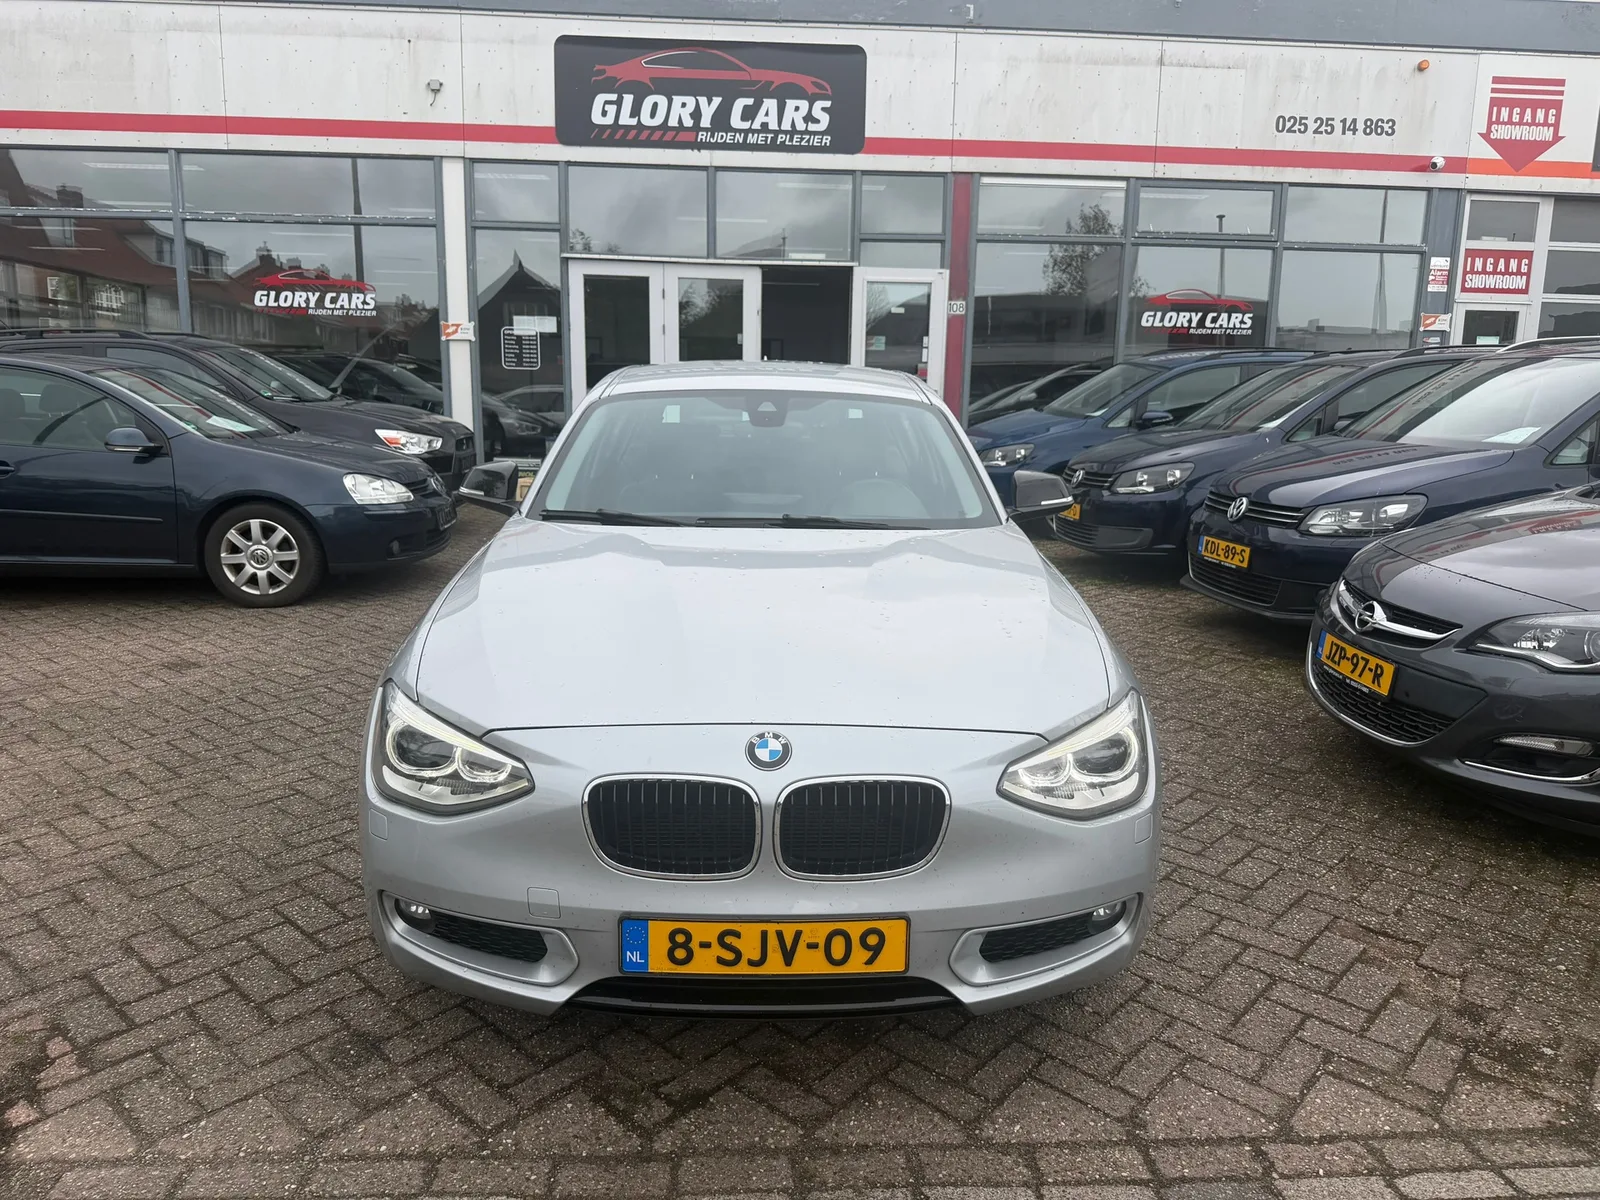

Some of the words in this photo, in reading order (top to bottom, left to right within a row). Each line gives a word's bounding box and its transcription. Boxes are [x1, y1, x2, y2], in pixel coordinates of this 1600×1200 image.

[591, 93, 722, 128] GLORY
[730, 98, 832, 132] CARS
[1491, 106, 1557, 124] INGANG
[1275, 115, 1308, 134] 025
[1312, 116, 1335, 135] 25
[1340, 117, 1358, 136] 14
[1362, 118, 1396, 137] 863
[1490, 124, 1554, 141] SHOWROOM
[697, 131, 744, 144] RIJDEN
[746, 133, 774, 145] MET
[776, 134, 831, 147] PLEZIER
[1466, 257, 1529, 273] INGANG
[1465, 273, 1527, 290] SHOWROOM
[254, 290, 320, 308] GLORY
[324, 292, 376, 310] CARS
[948, 302, 965, 313] 108
[308, 308, 332, 316] RIJDEN
[348, 309, 377, 317] PLEZIER
[1141, 311, 1202, 327] GLORY
[1204, 312, 1254, 329] CARS
[1203, 538, 1246, 564] KDL-89-S
[1325, 640, 1385, 688] JZP-97-R
[751, 731, 787, 744] BMW
[667, 927, 886, 967] 8-SJV-09
[626, 950, 645, 963] NL
